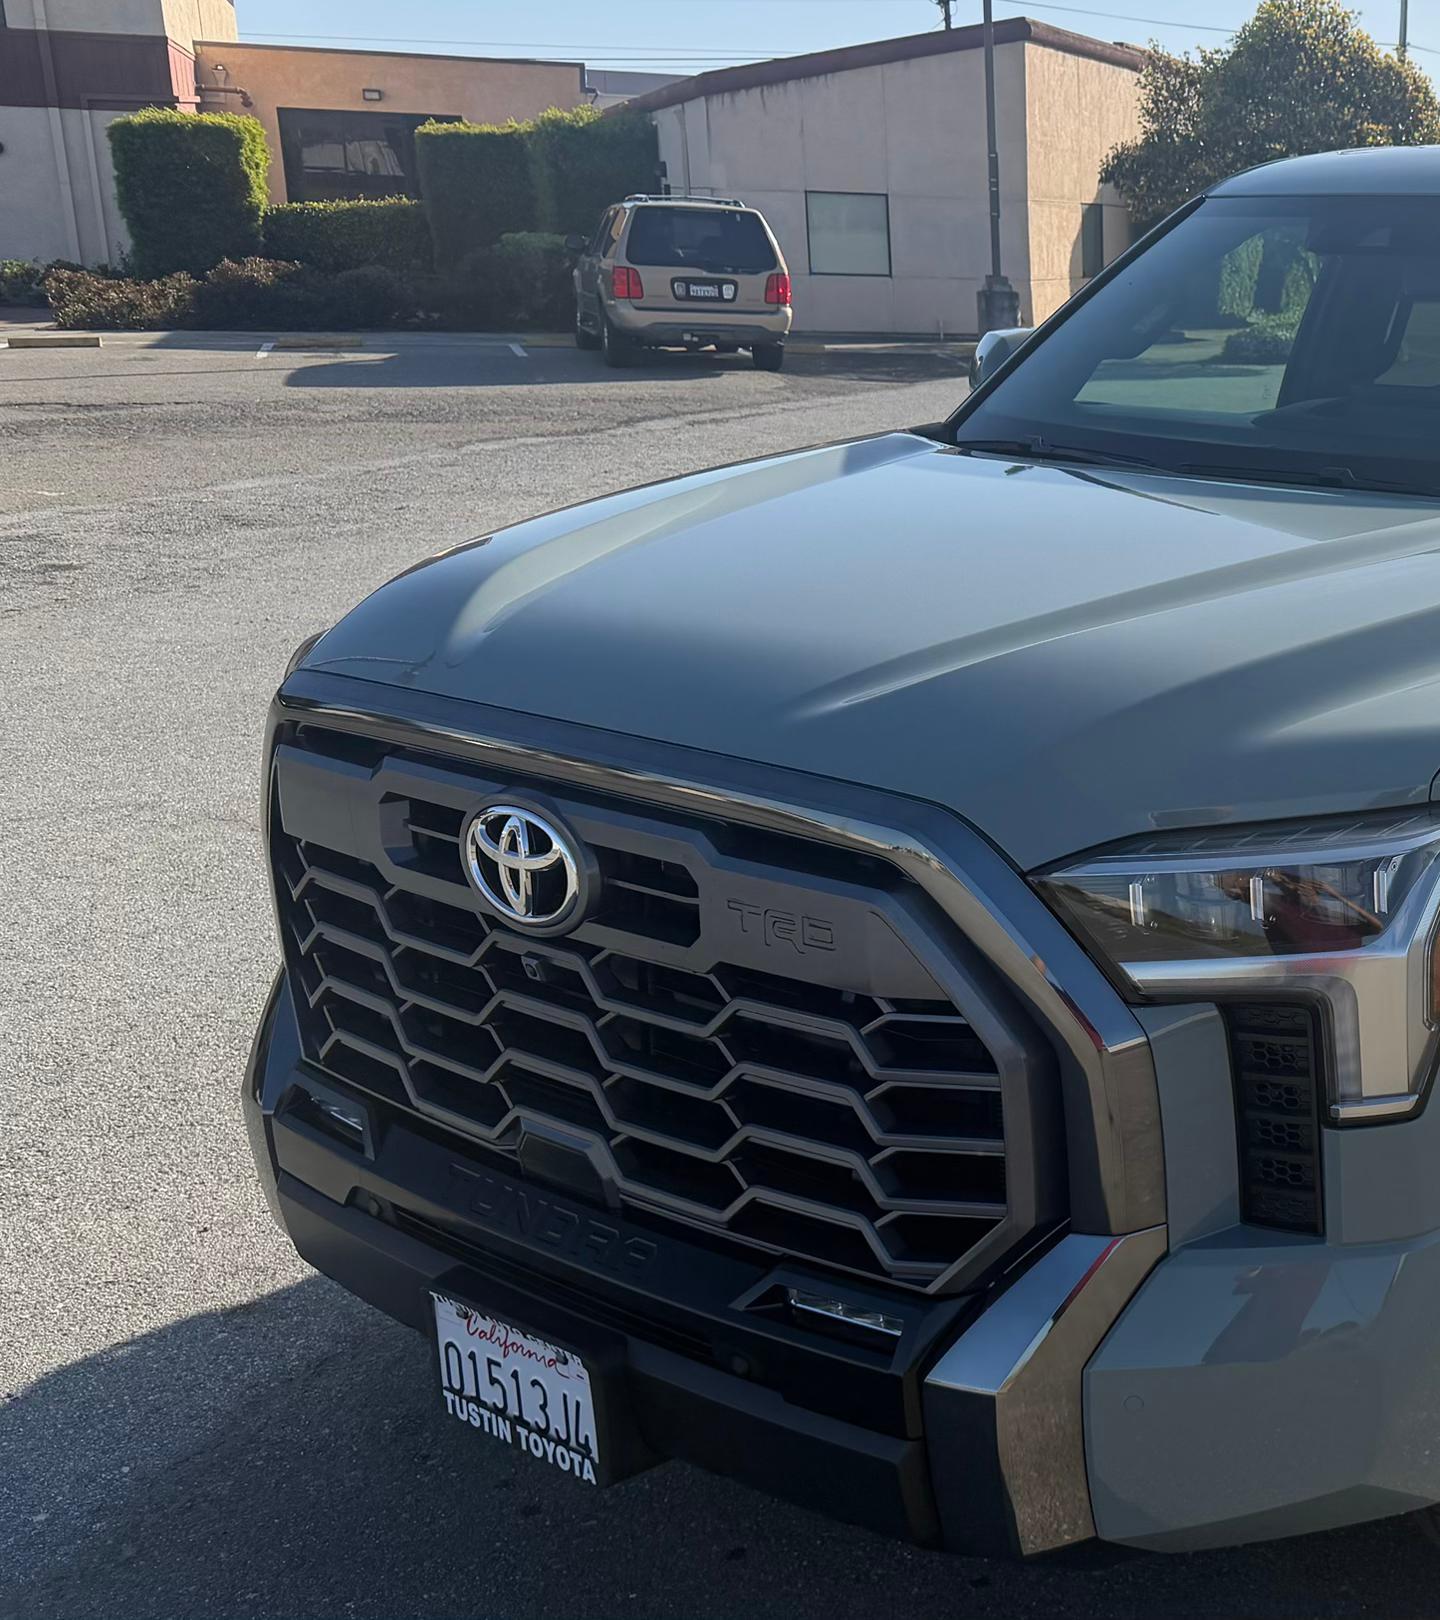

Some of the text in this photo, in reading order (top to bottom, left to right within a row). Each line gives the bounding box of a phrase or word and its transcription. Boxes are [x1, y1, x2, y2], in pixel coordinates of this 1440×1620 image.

[726, 898, 838, 955] TRD
[447, 1163, 659, 1273] TUNDRA
[466, 1313, 570, 1379] California
[443, 1390, 598, 1485] TUSTIN TOYOTA
